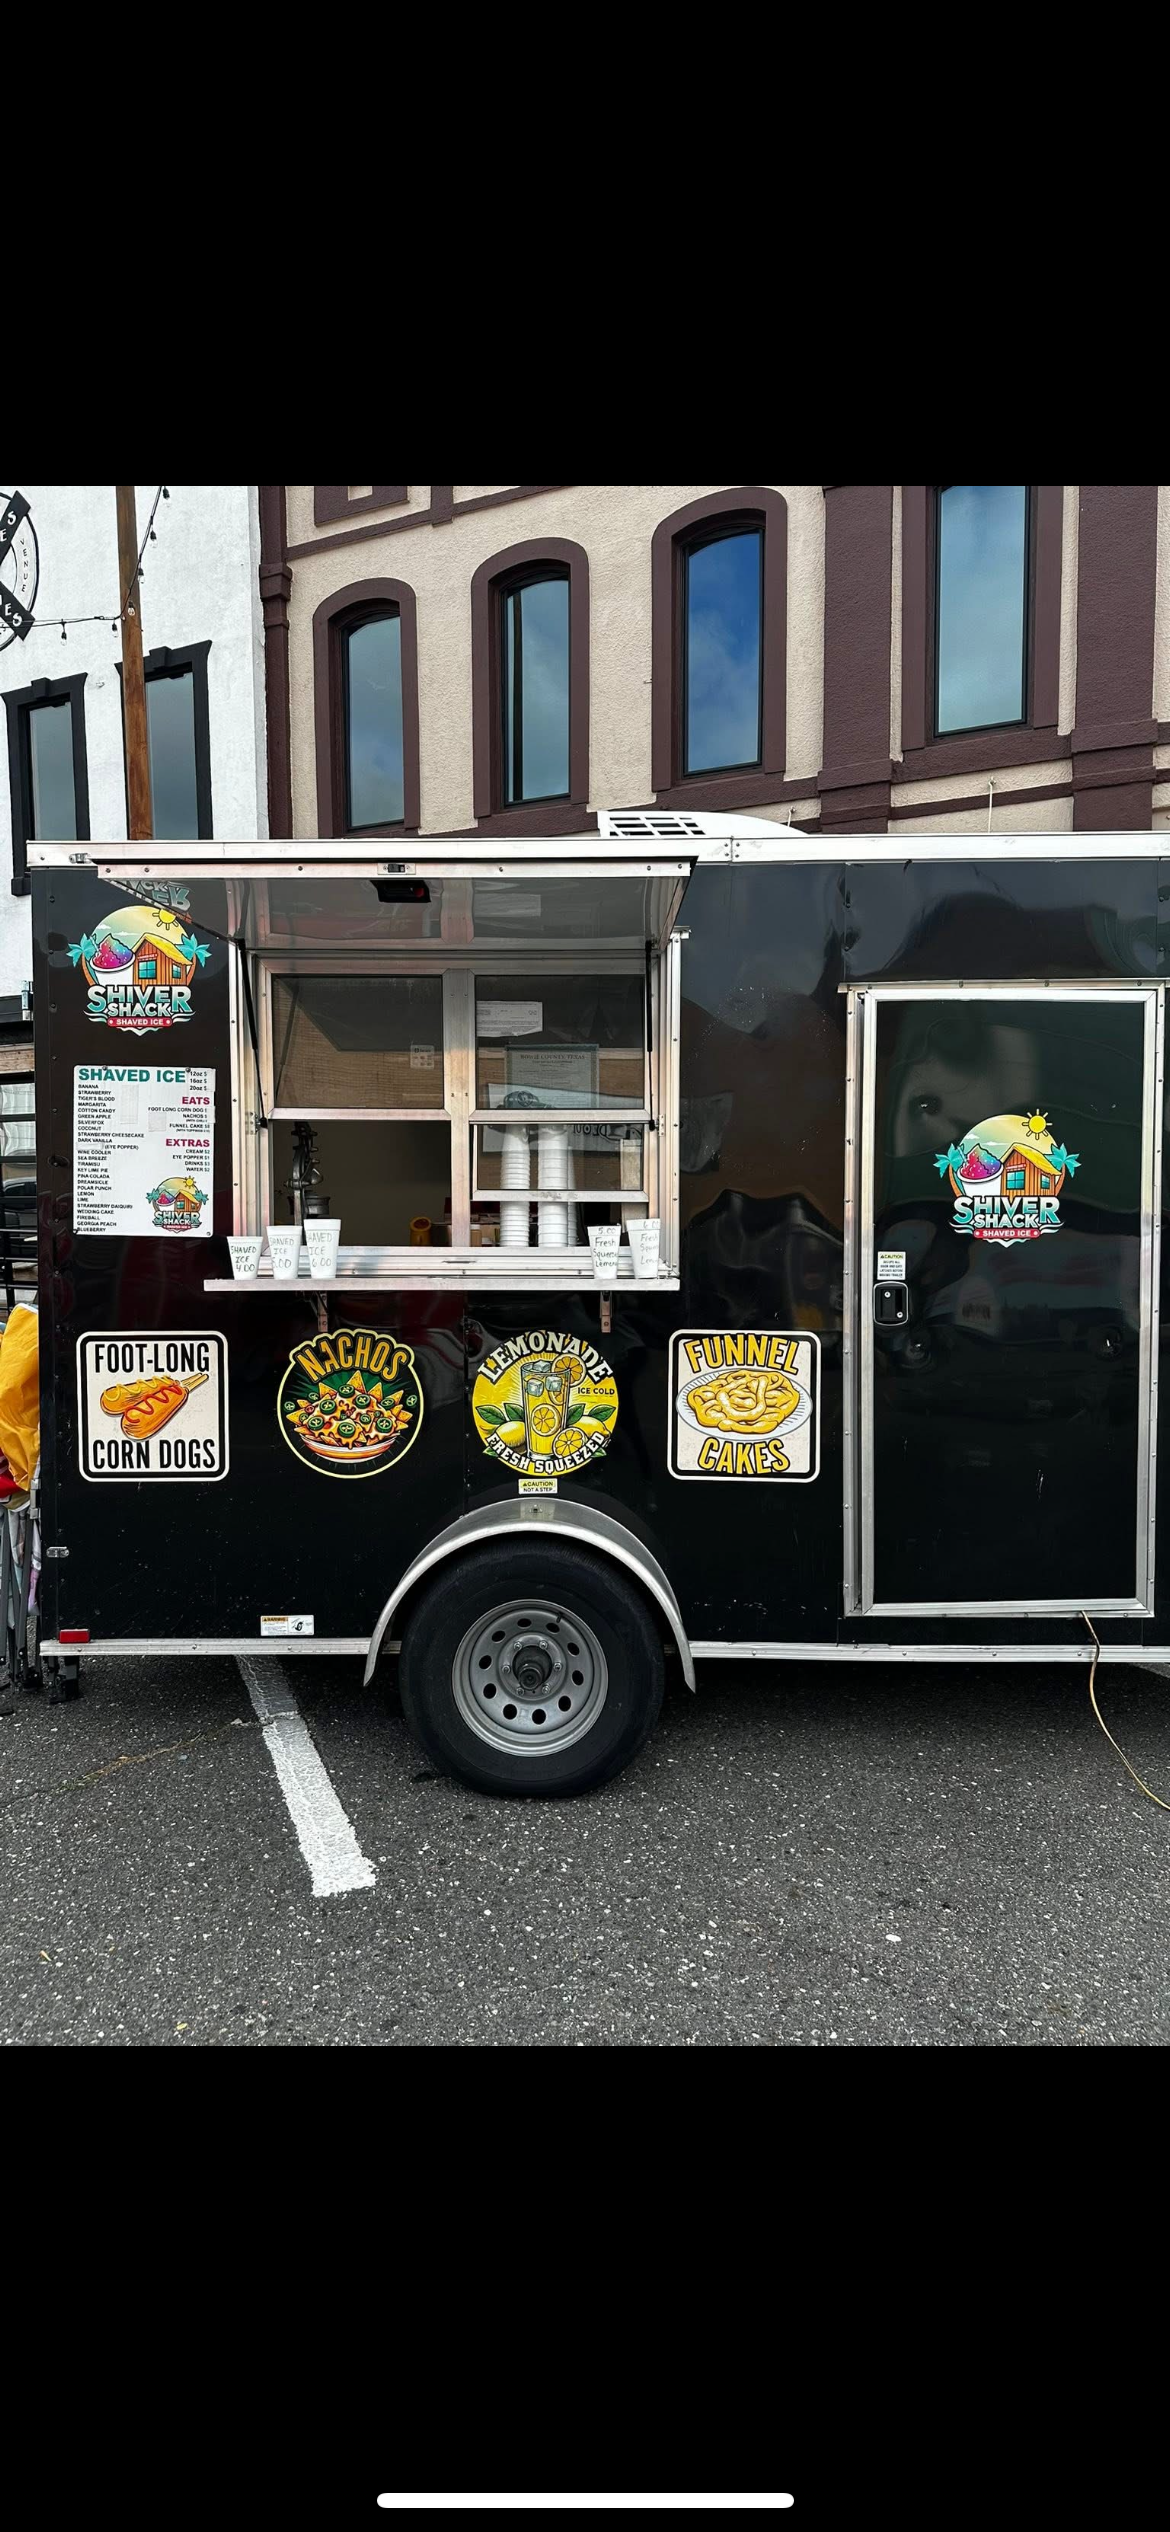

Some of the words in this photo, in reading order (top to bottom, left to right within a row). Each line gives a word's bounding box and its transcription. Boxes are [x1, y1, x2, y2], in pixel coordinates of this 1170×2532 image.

[20, 538, 29, 593] VENUE
[86, 984, 193, 1013] SHIVER
[107, 1002, 171, 1017] SHACK
[116, 1018, 148, 1026] SHAVED
[150, 1018, 164, 1026] ICE
[78, 1068, 151, 1082] SHAVED
[157, 1070, 186, 1083] ICE
[182, 1096, 210, 1105] EATS
[166, 1139, 210, 1147] EXTRAS
[154, 1210, 201, 1225] SHIVER
[952, 1196, 1061, 1224] SHIVER
[974, 1214, 1039, 1228] SHACK
[595, 1237, 616, 1247] Fresh
[230, 1246, 257, 1254] SHAVED
[309, 1247, 325, 1255] ICE
[94, 1342, 210, 1373] FOOT-LONG
[297, 1336, 408, 1381] NACHOS
[477, 1331, 614, 1383] LEMONADE
[684, 1334, 800, 1375] FUNNEL
[578, 1387, 590, 1395] ICE
[593, 1387, 615, 1395] COLD
[92, 1438, 150, 1469] CORN
[159, 1438, 216, 1469] DOGS
[486, 1433, 531, 1471] FRESH
[533, 1432, 606, 1475] SQUEEZED
[698, 1438, 790, 1475] CAKES
